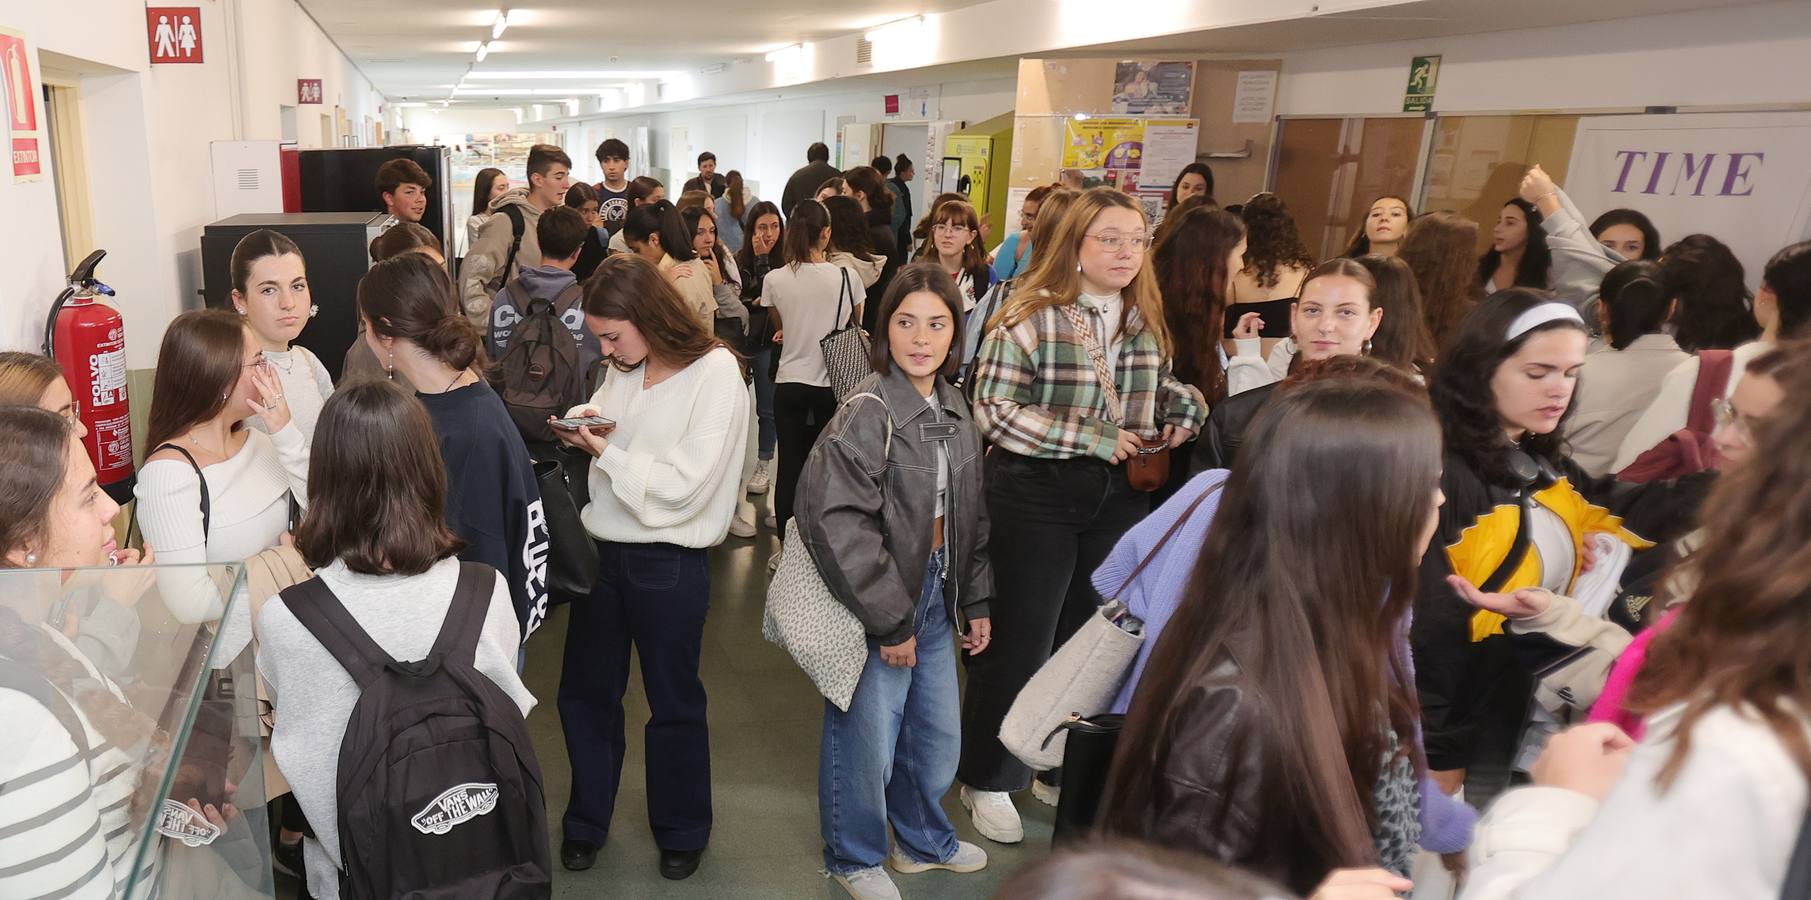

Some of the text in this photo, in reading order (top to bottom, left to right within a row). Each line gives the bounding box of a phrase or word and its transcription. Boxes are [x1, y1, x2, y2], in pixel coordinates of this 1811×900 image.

[1611, 151, 1764, 196] TIME
[89, 354, 102, 407] POLVO
[437, 791, 468, 812] VANS
[447, 801, 468, 819] THE
